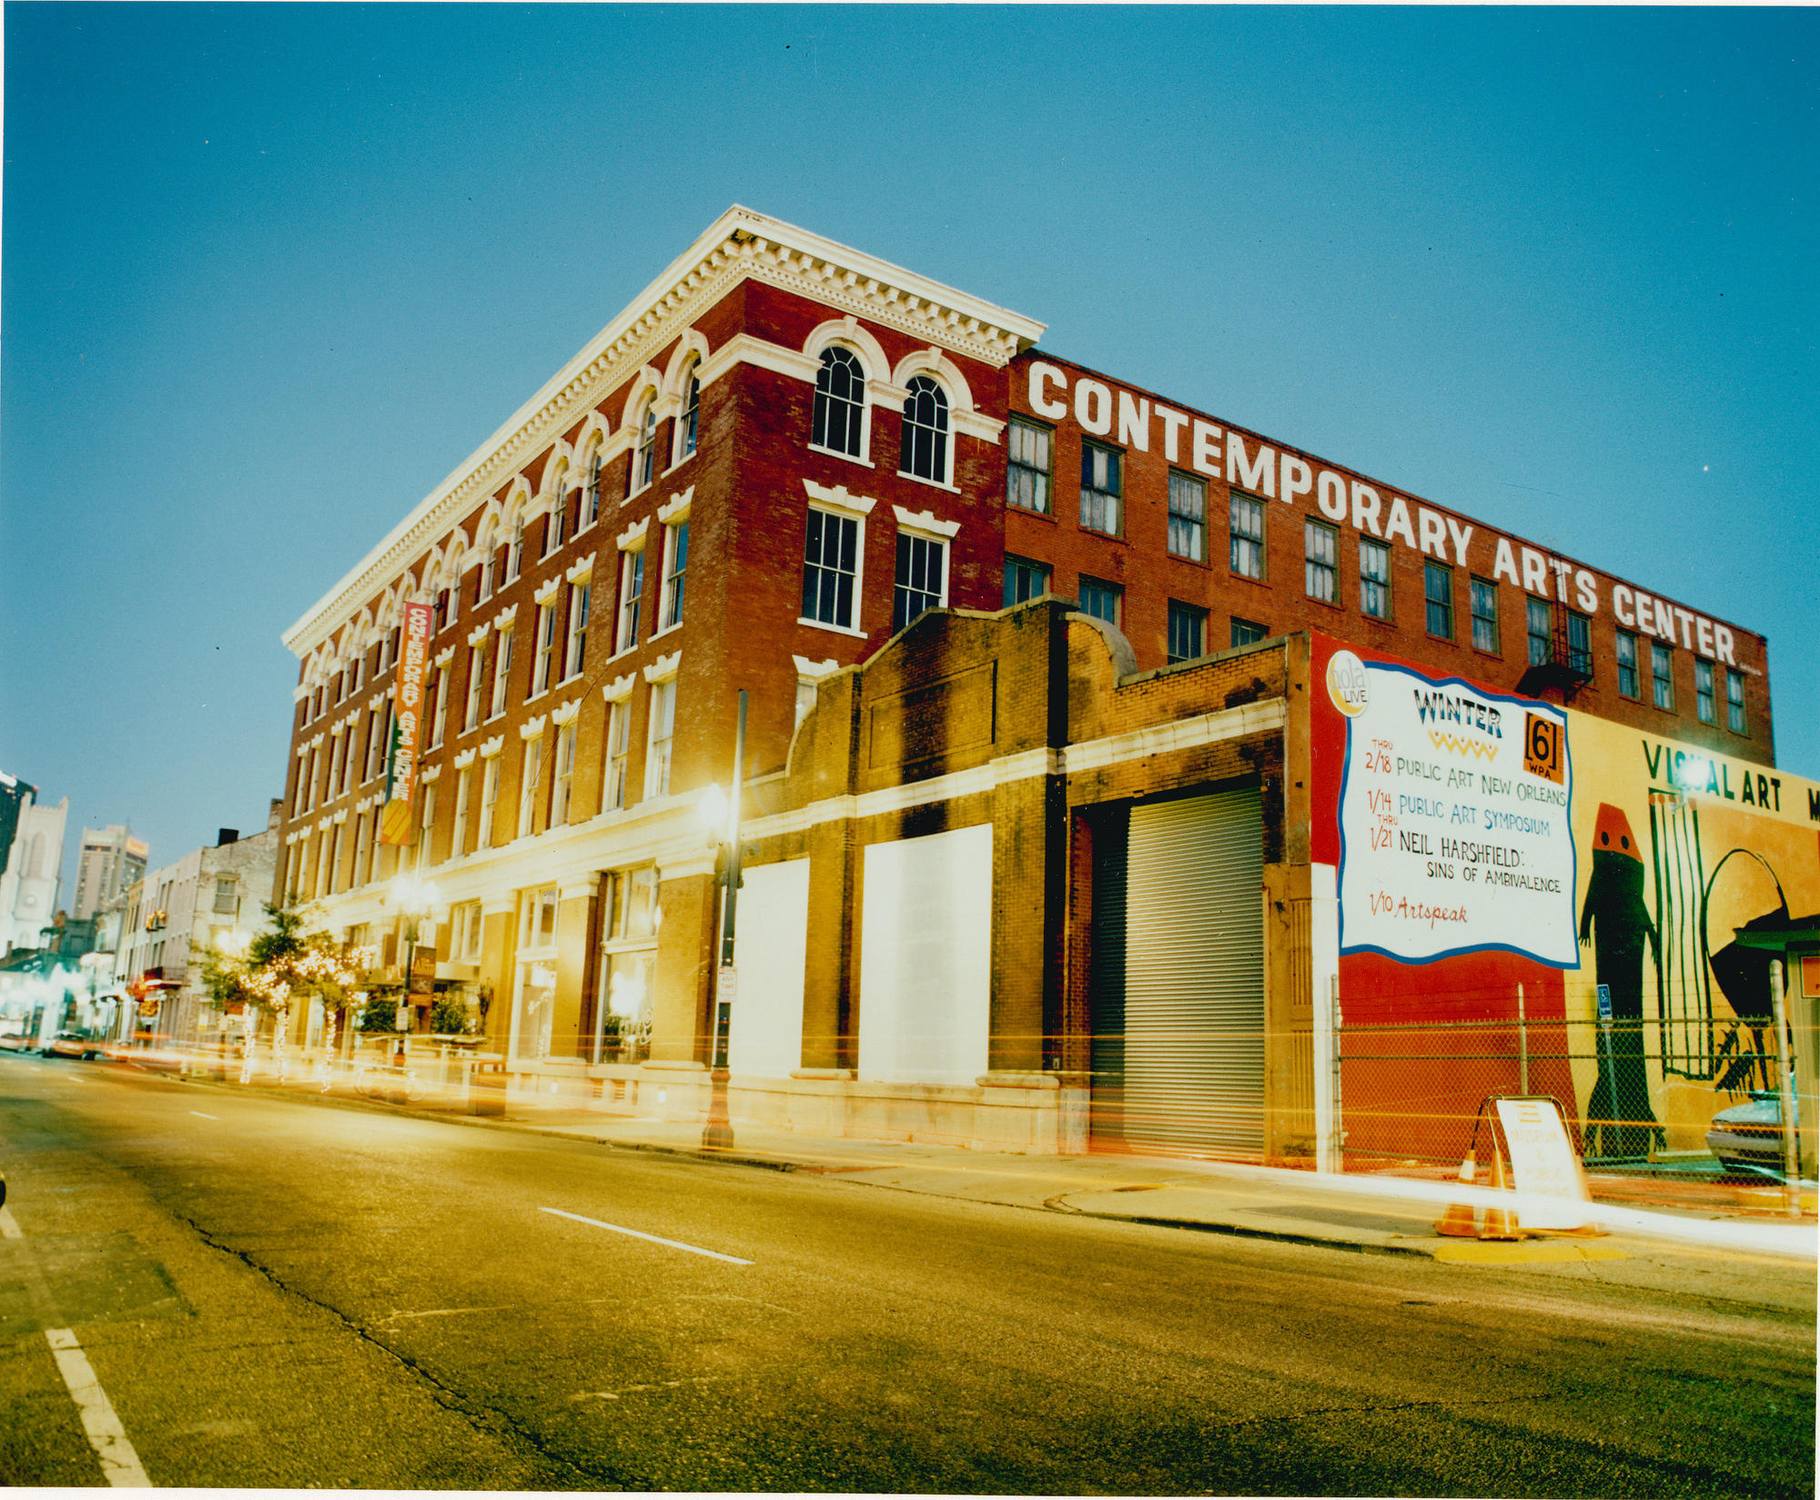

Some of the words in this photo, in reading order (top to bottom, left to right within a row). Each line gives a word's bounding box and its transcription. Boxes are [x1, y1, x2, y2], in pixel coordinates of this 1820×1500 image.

[1028, 361, 1474, 567] CONTEMPORARY
[1493, 538, 1598, 613] ARTS
[1613, 584, 1737, 665] CENTER
[1343, 688, 1368, 704] LIVE
[1413, 688, 1503, 739] WINTER
[1372, 738, 1393, 751] THRU
[1365, 750, 1392, 774] 2/18
[1397, 756, 1442, 782] PUBLIC
[1447, 767, 1475, 789] ART
[1481, 774, 1512, 796] NEW
[1516, 782, 1567, 808] ORLEANS
[1529, 761, 1552, 780] WPA
[1641, 739, 1735, 801] VIAL
[1742, 769, 1781, 812] ART
[1367, 789, 1392, 815] 1/14
[1399, 794, 1444, 819] PUBLIC
[1450, 804, 1477, 825] ART
[1483, 809, 1551, 838] SYMPOSIUM
[1377, 813, 1398, 826] THRU
[1370, 824, 1393, 852] 1/21
[1399, 829, 1434, 856] NEIL
[1426, 861, 1455, 880] SINS
[1462, 866, 1478, 882] OF
[1484, 868, 1561, 894] AMBIVALENCE
[1369, 890, 1393, 916] 1/10
[1394, 895, 1468, 929] Artspeak
